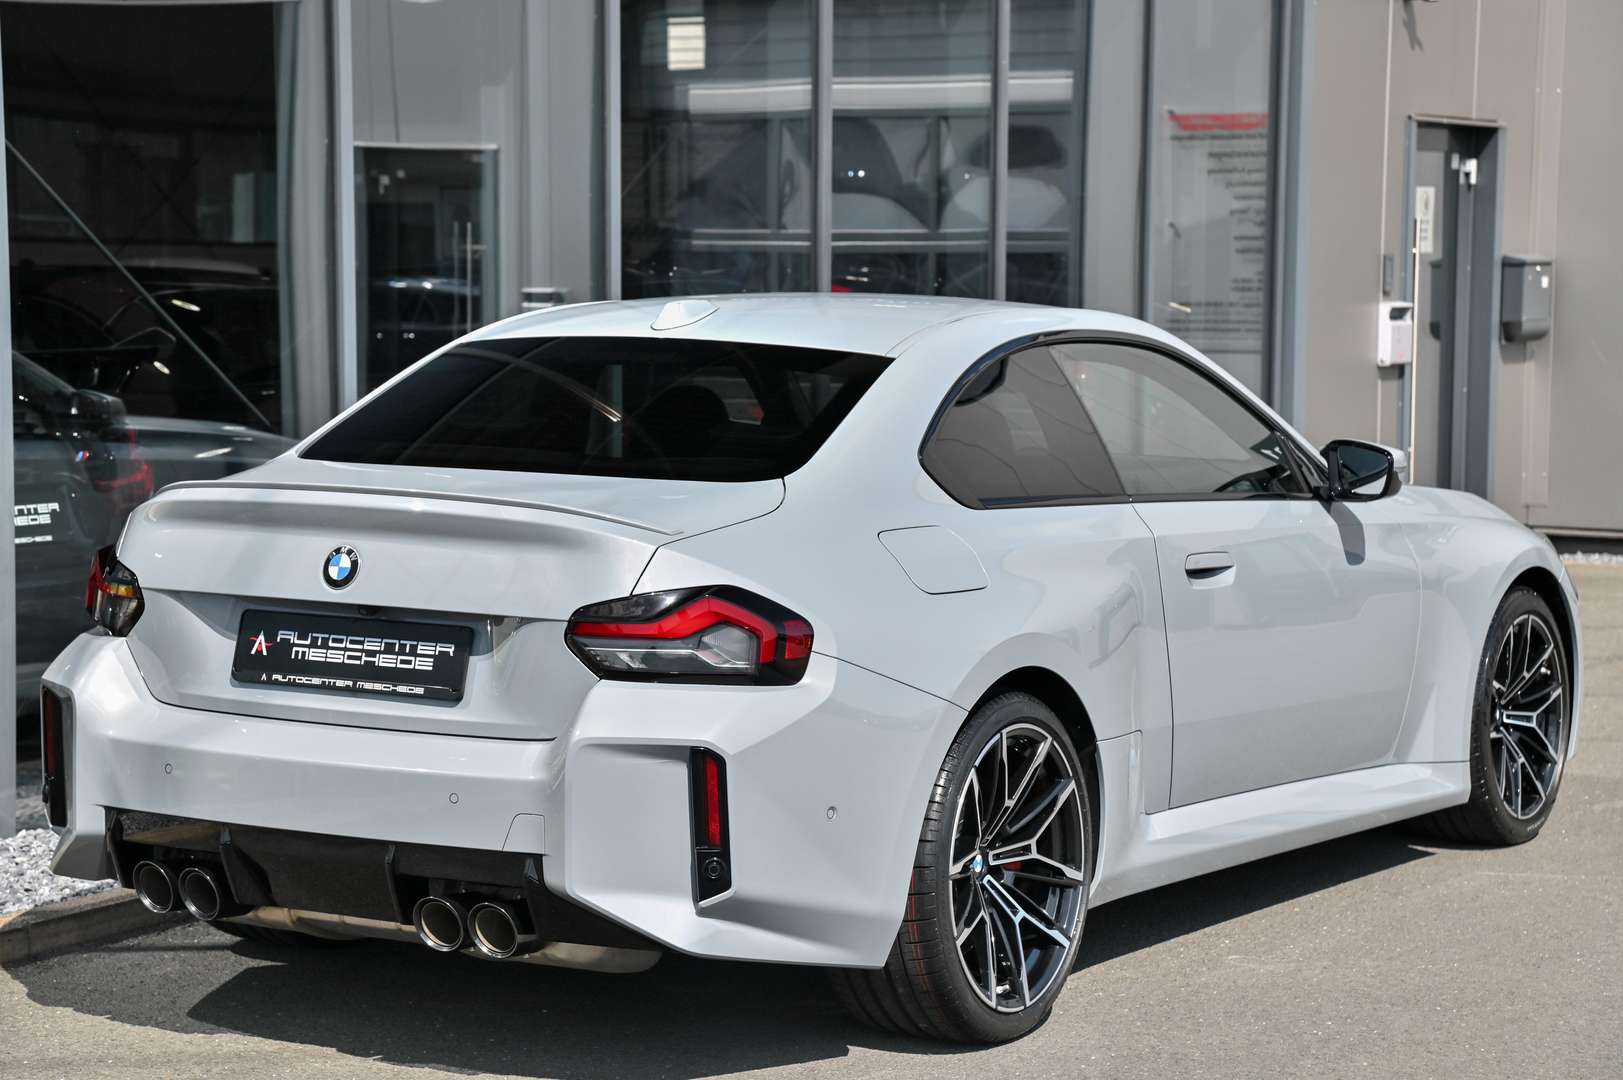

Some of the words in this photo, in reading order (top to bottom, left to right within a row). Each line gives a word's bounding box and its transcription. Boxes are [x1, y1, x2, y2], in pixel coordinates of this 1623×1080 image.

[277, 630, 455, 656] AUTOCENTER
[291, 646, 434, 670] MESCHEDE
[271, 674, 353, 688] AUTOCENTER
[356, 681, 425, 695] MESCHEDE
